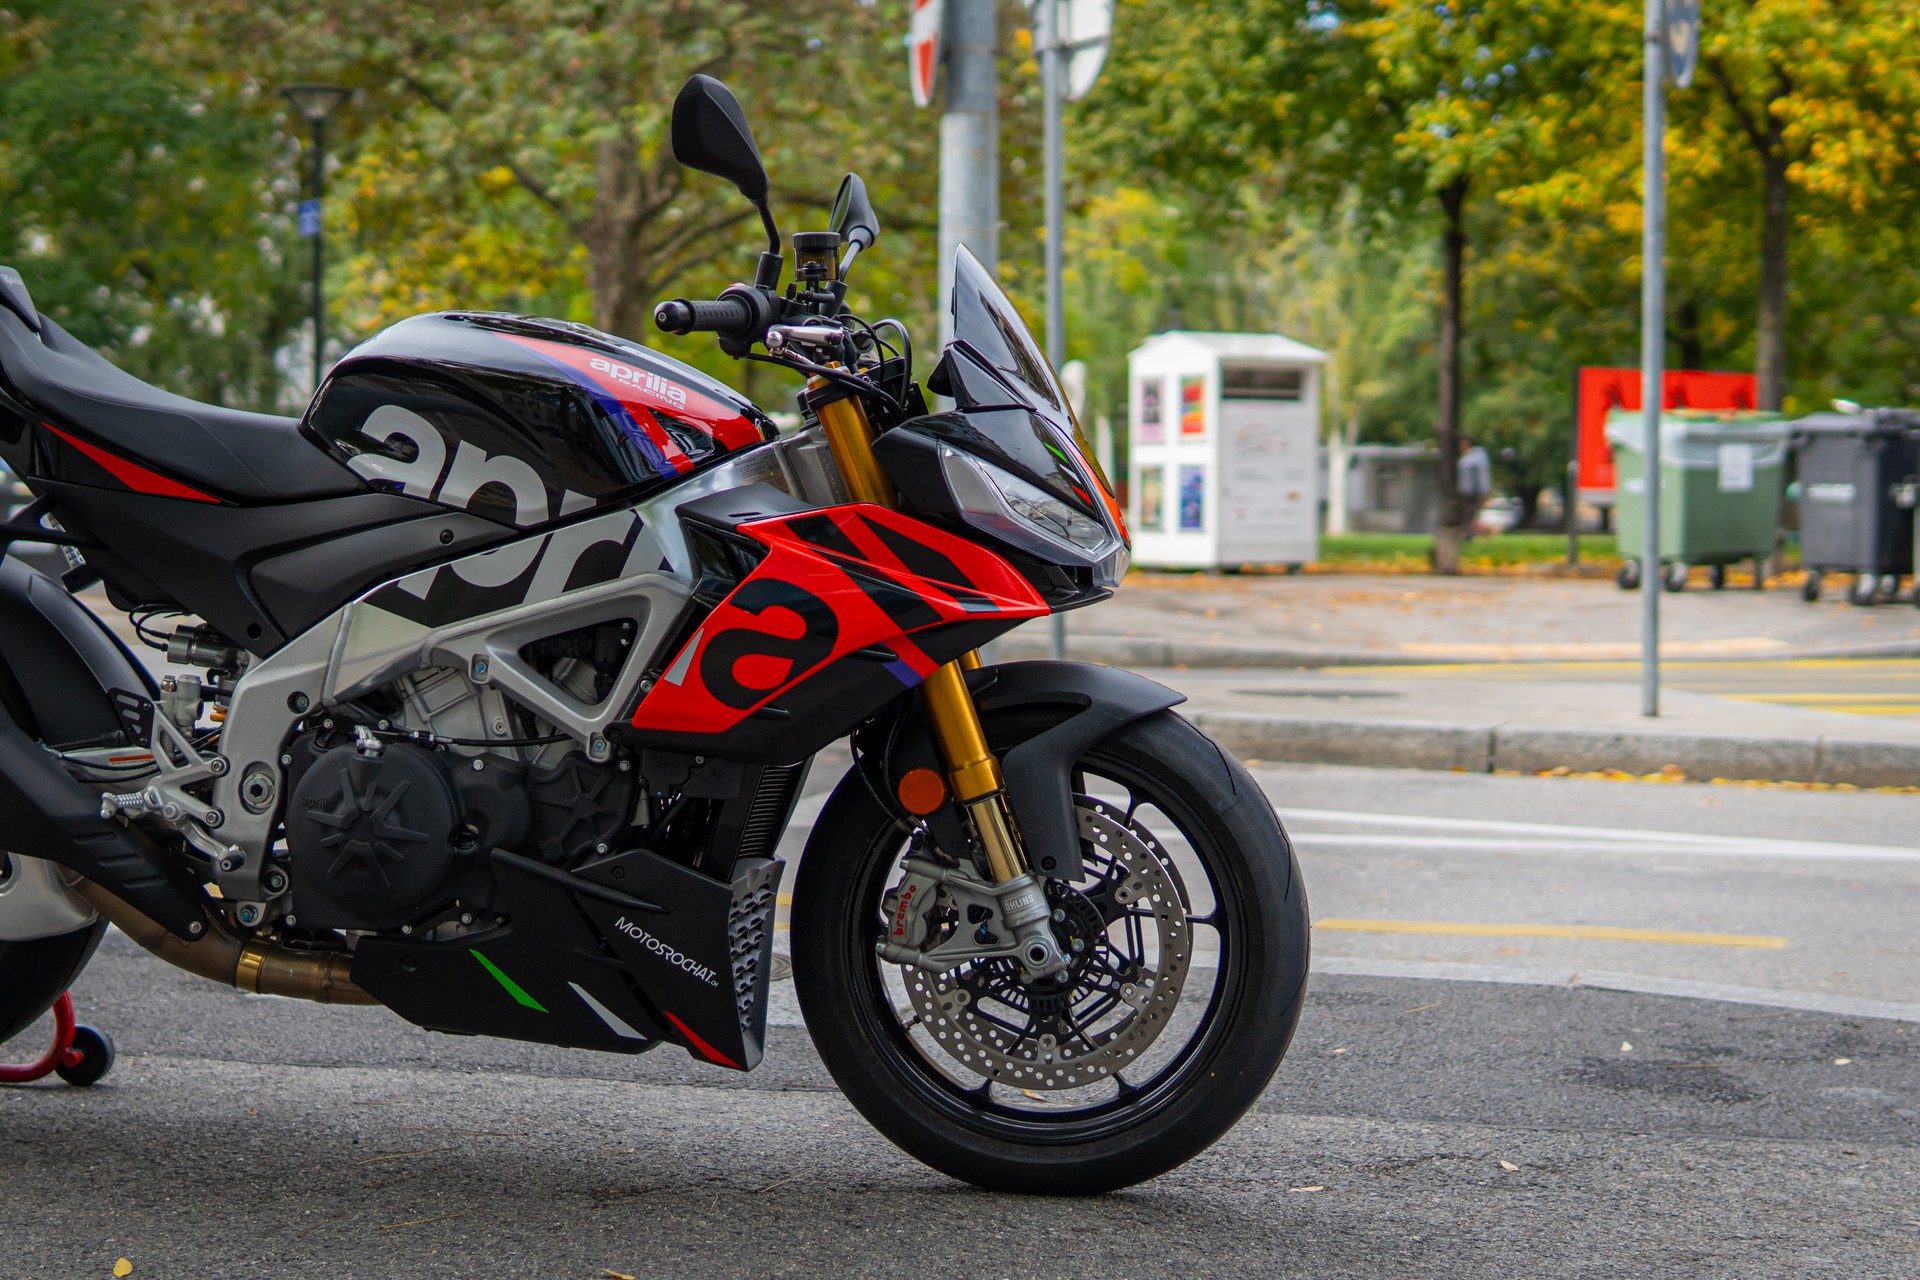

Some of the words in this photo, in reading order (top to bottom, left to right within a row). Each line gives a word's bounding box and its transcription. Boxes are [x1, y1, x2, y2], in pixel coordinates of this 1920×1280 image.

[589, 357, 687, 405] aprilia
[618, 378, 685, 411] RACING
[893, 885, 917, 936] brembo
